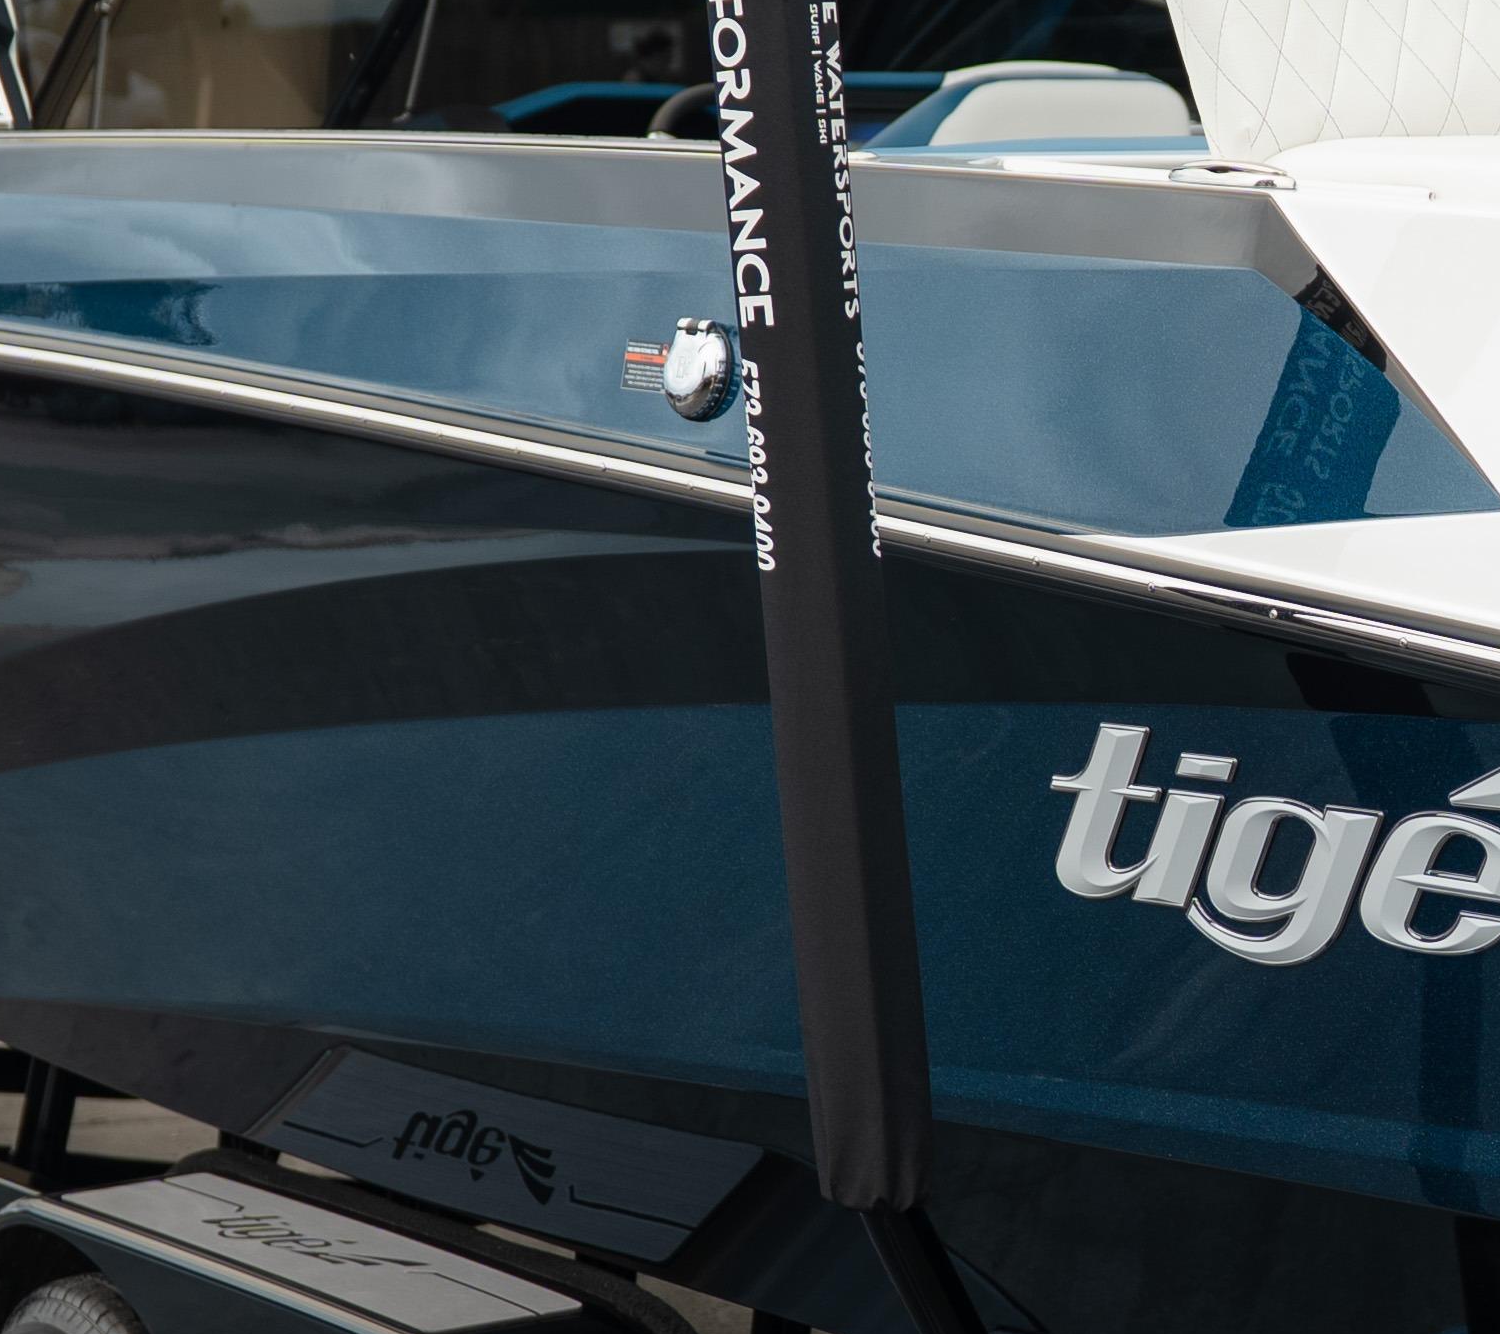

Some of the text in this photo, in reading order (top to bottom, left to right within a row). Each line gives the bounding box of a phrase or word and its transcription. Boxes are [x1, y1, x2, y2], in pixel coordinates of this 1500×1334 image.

[809, 3, 821, 45] SURF
[813, 59, 825, 104] WAKE
[817, 118, 828, 144] SKI
[825, 39, 860, 320] WATERSPORTS
